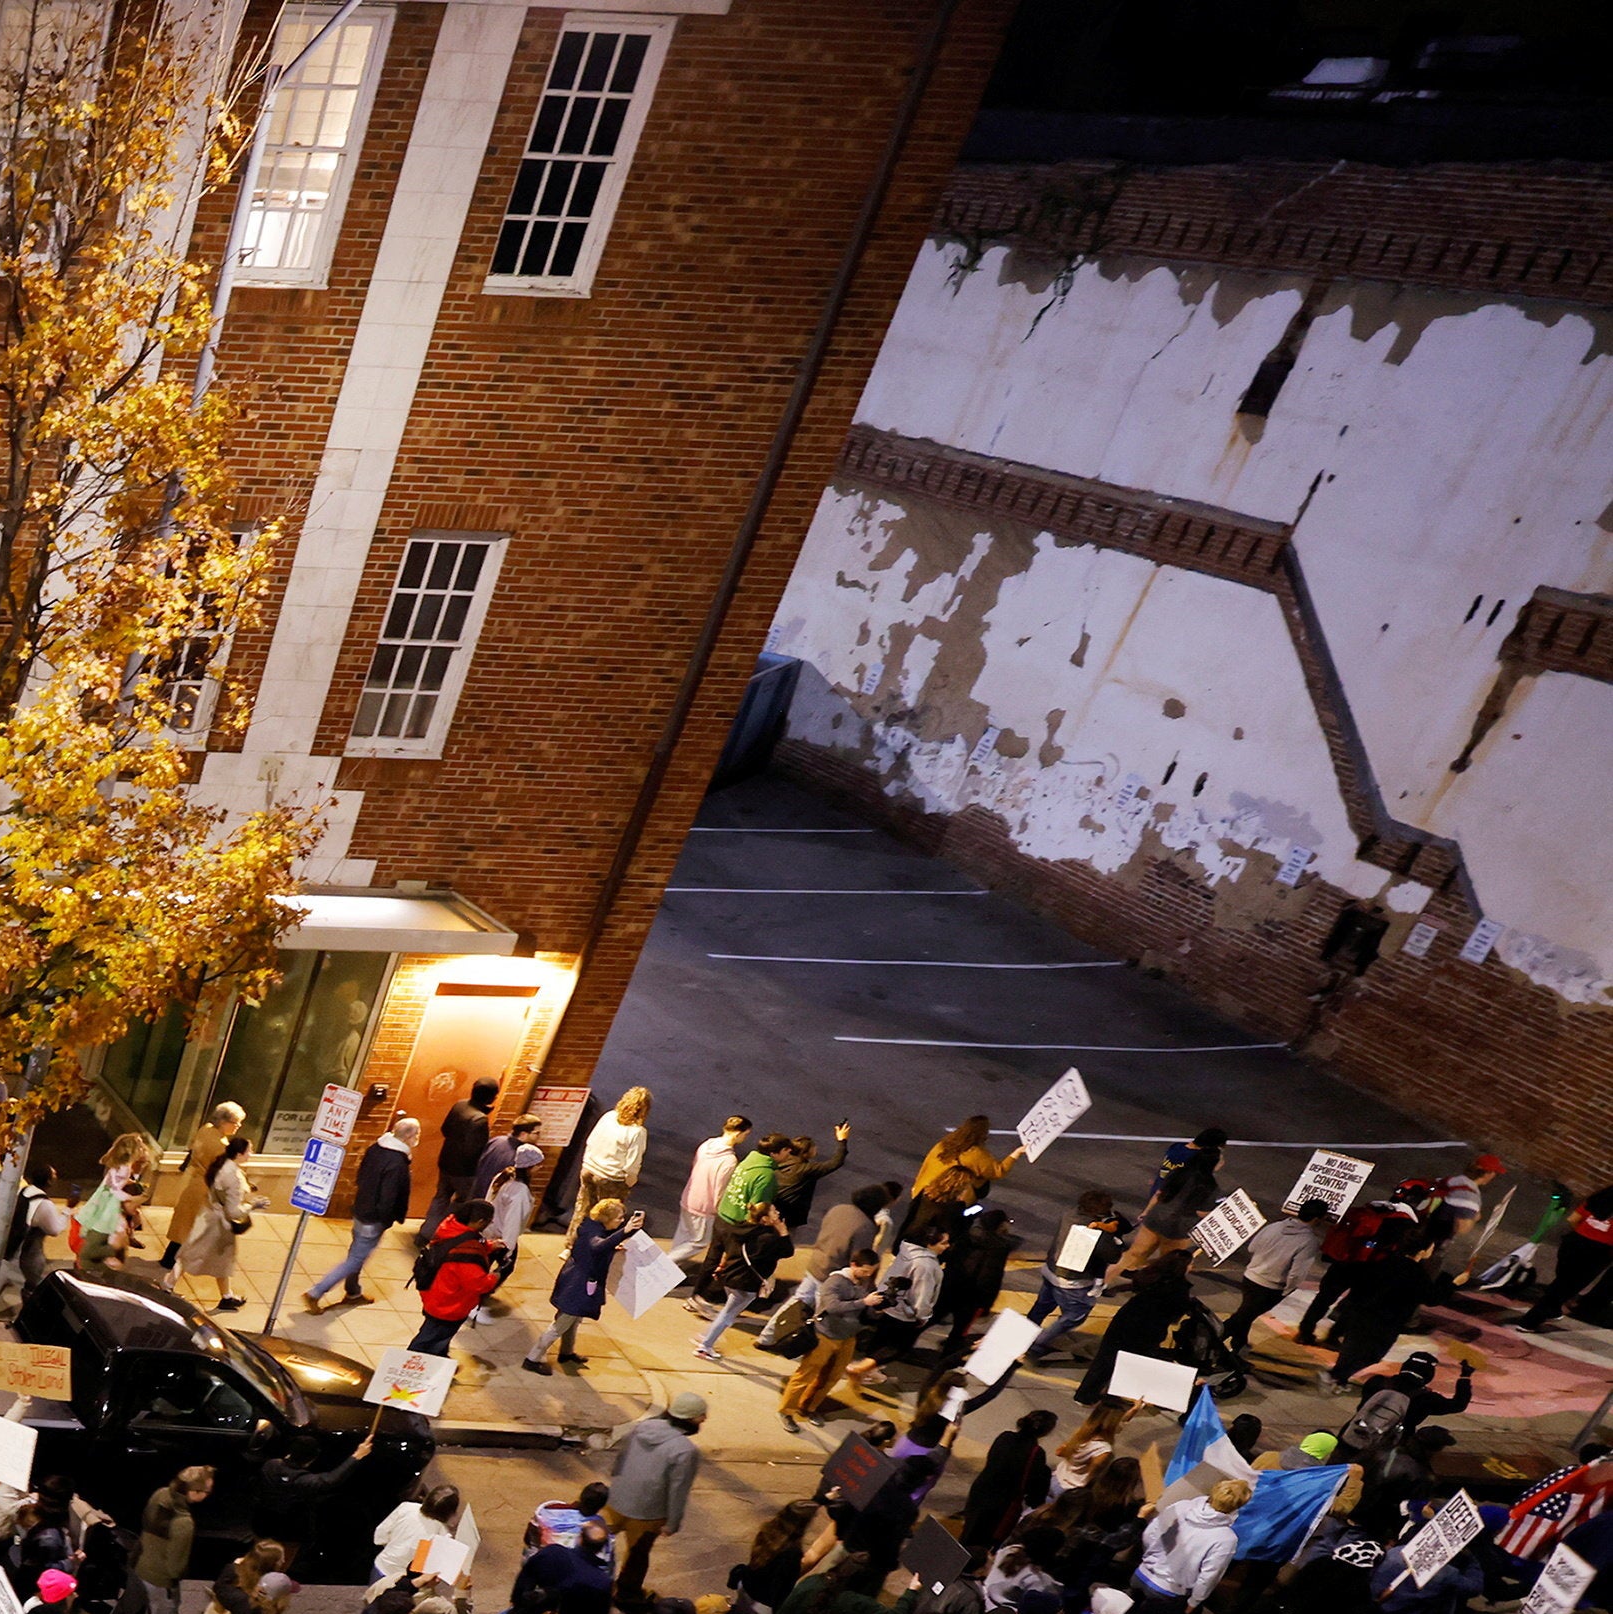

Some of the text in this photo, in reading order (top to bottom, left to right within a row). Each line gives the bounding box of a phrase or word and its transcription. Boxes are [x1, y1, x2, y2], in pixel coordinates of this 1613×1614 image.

[326, 1104, 349, 1119] ANY
[322, 1115, 347, 1131] TIME
[309, 1143, 317, 1159] 1
[1308, 1162, 1363, 1184] DEPORTACIONES
[1325, 1156, 1357, 1172] NO MAS
[1311, 1173, 1348, 1191] CONTRA
[1301, 1182, 1347, 1204] NUESTRAS
[1227, 1191, 1261, 1230] MONEY FOR
[1215, 1201, 1252, 1240] MEDICAID
[1205, 1215, 1223, 1232] NOT
[1214, 1228, 1236, 1251] MASS
[386, 1366, 420, 1379] SILENCE
[382, 1374, 438, 1392] COMPLICITY
[1438, 1494, 1486, 1543] DEFEND
